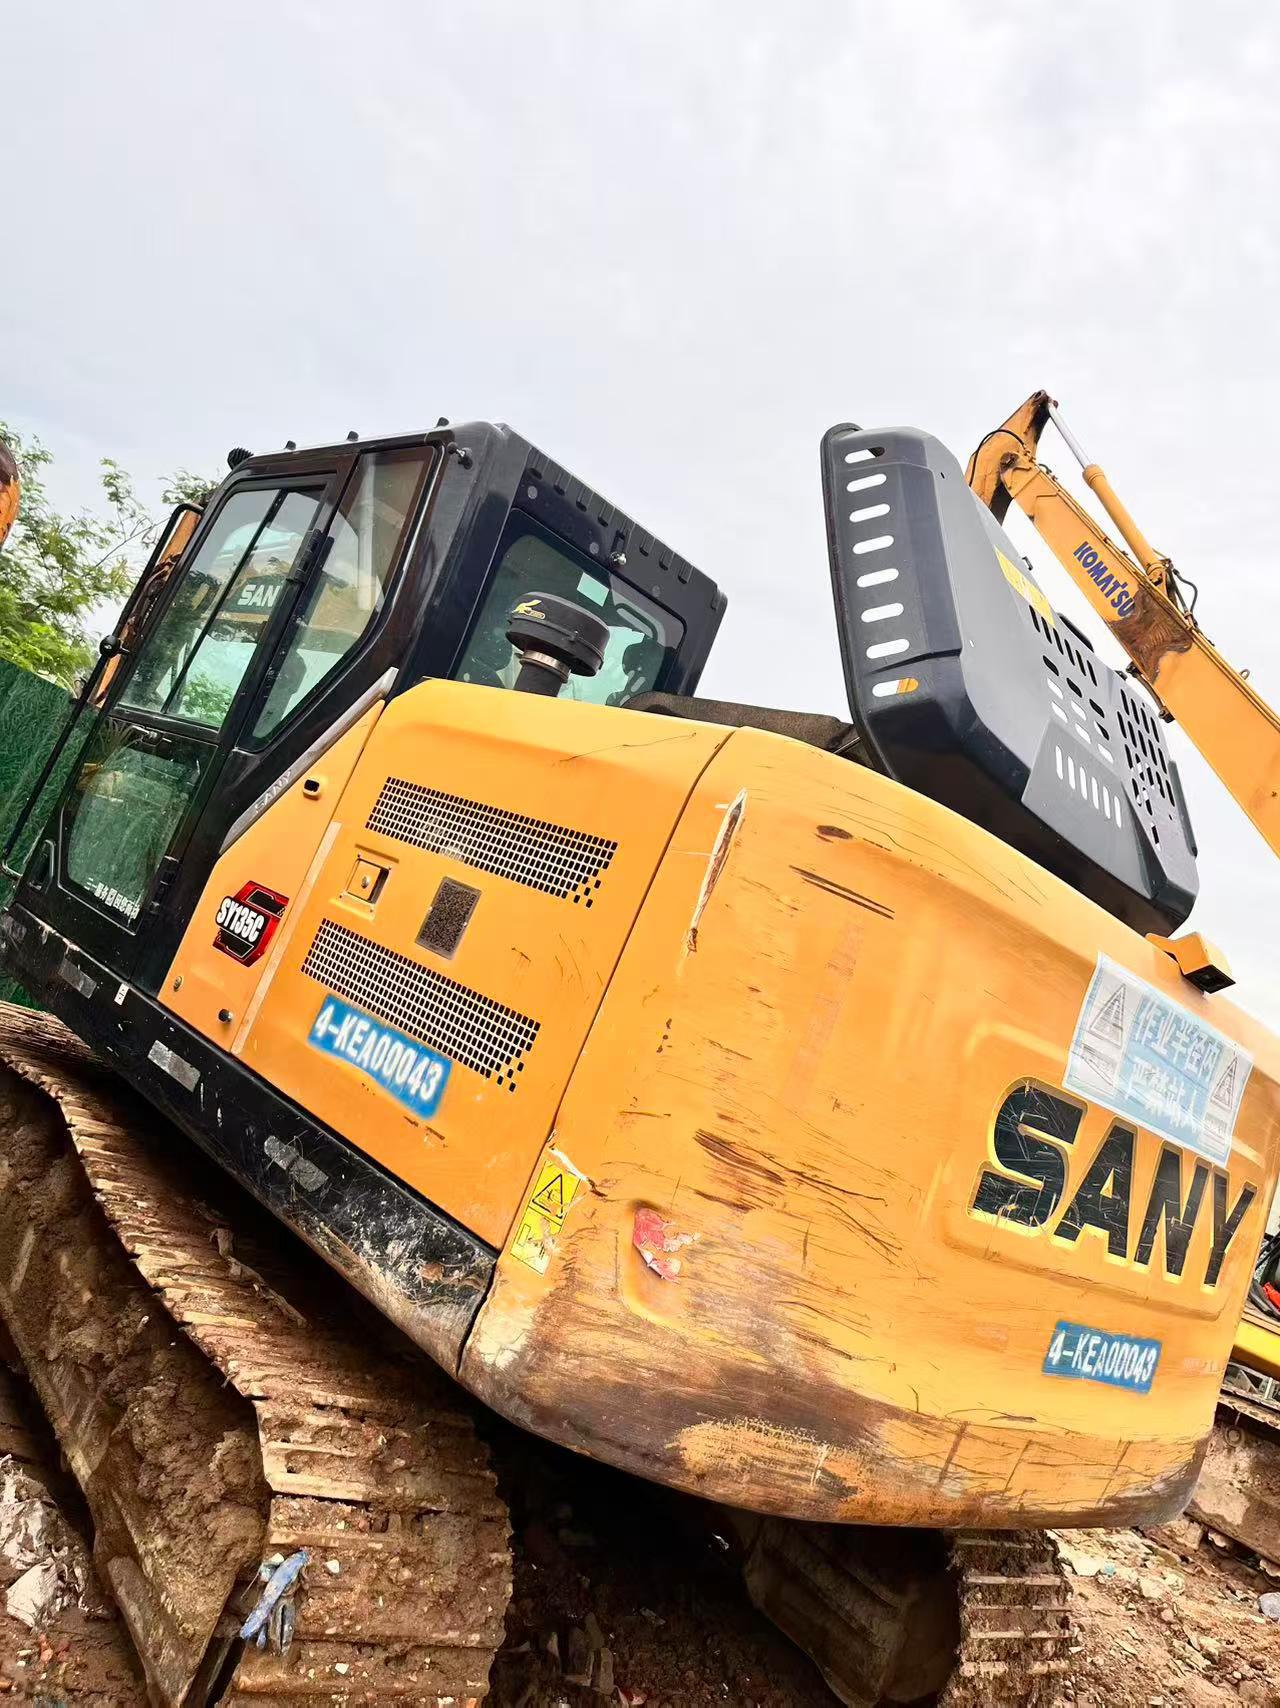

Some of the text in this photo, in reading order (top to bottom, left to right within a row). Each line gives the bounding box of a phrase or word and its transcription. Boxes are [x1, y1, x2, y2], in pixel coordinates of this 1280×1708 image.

[237, 584, 280, 607] SAN
[1073, 541, 1136, 617] KOMATSU
[216, 897, 265, 942] SY135C
[314, 1004, 443, 1100] 4-KEA00043
[970, 1080, 1257, 1291] SANY
[1049, 1330, 1157, 1384] 4-KEA00043
